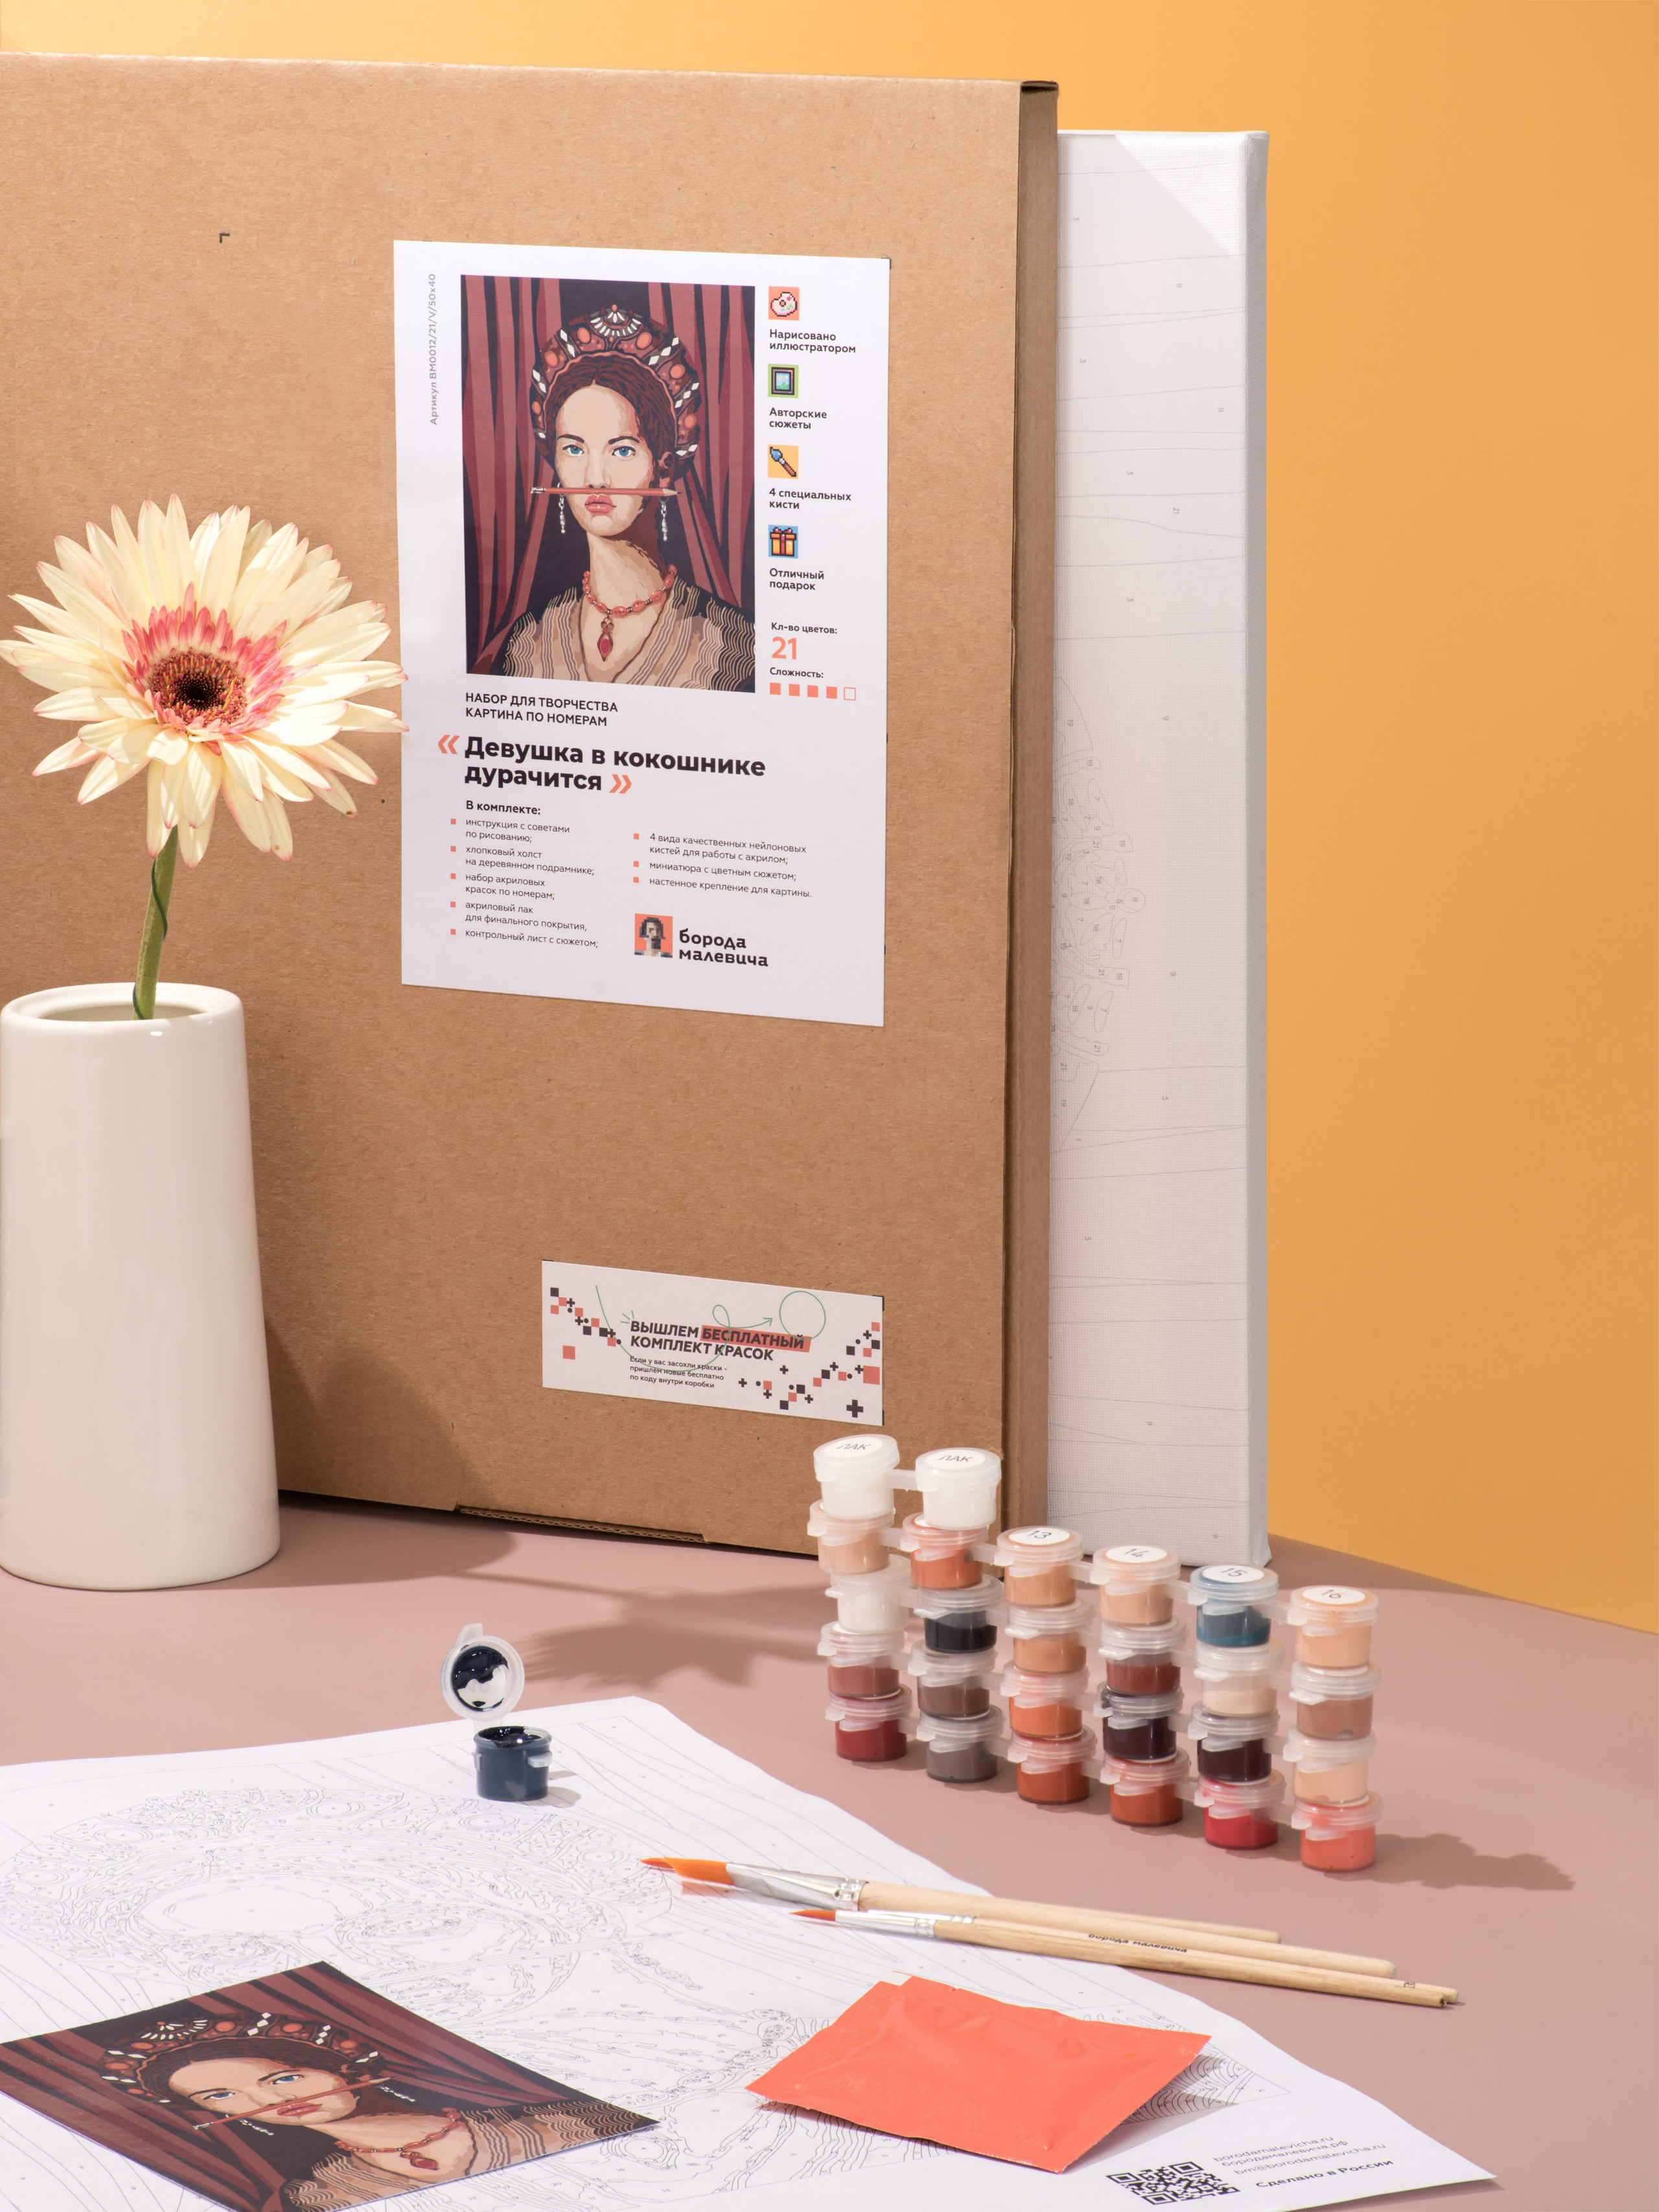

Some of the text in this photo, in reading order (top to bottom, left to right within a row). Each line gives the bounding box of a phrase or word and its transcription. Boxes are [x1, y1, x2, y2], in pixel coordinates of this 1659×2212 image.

[770, 329, 836, 340] Нарисовано
[770, 343, 855, 354] иллюстратором
[430, 382, 439, 425] Артикул
[770, 408, 827, 419] Авторские
[779, 491, 851, 500] специальных
[770, 568, 824, 579] Отличный
[770, 581, 815, 591] подарок
[772, 622, 799, 631] Кл-во
[772, 637, 796, 659] 21
[770, 668, 823, 678] Сложность:
[466, 693, 618, 712] НАБОР ДЛЯ ТВОРЧЕСТВА
[466, 708, 607, 726] КАРТИНА ПО НОМЕРАМ
[592, 749, 605, 764] в
[614, 751, 765, 776] кокошнике
[467, 800, 540, 815] В комплекте:
[467, 820, 517, 829] инструкция
[480, 833, 531, 843] рисованию;
[684, 838, 746, 848] качественных
[750, 842, 806, 852] нейлоновых
[466, 847, 514, 856] хлопковый
[702, 850, 736, 859] работы
[746, 855, 787, 865] акрилом;
[479, 860, 534, 869] деревянном
[537, 865, 594, 876] подрамнике;
[650, 863, 701, 873] миниатюра
[754, 872, 796, 881] сюжетом;
[466, 874, 544, 886] набор акриловых
[650, 879, 697, 888] настенное
[700, 883, 748, 892] крепление
[513, 891, 554, 900] номерам;
[466, 903, 515, 911] акриловый
[485, 915, 539, 926] финального
[542, 921, 586, 931] покрытия,
[466, 931, 524, 940] контрольный
[557, 938, 597, 948] сюжетом;
[680, 928, 746, 950] борода
[679, 949, 768, 966] малевича
[630, 1321, 805, 1349] ВЫШЛЕМ БЕСПЛАТНЫЙ
[630, 1336, 774, 1361] КОМПЛЕКТ КРАСОК
[667, 1360, 696, 1369] засохли
[697, 1364, 722, 1372] краски
[658, 1377, 683, 1386] внутри
[687, 1371, 725, 1380] бесплатно
[1028, 1530, 1051, 1539] 13
[1124, 1548, 1148, 1557] 14
[1221, 1568, 1248, 1577] 15
[1321, 1589, 1347, 1599] 16
[1212, 2136, 1335, 2162] borodamalevicha.ru
[1222, 2140, 1348, 2167] бородамалевича.рф
[1234, 2144, 1387, 2175] bm@borodamalevicha.ru
[1256, 2174, 1323, 2187] Сделано
[1338, 2161, 1393, 2173] России
